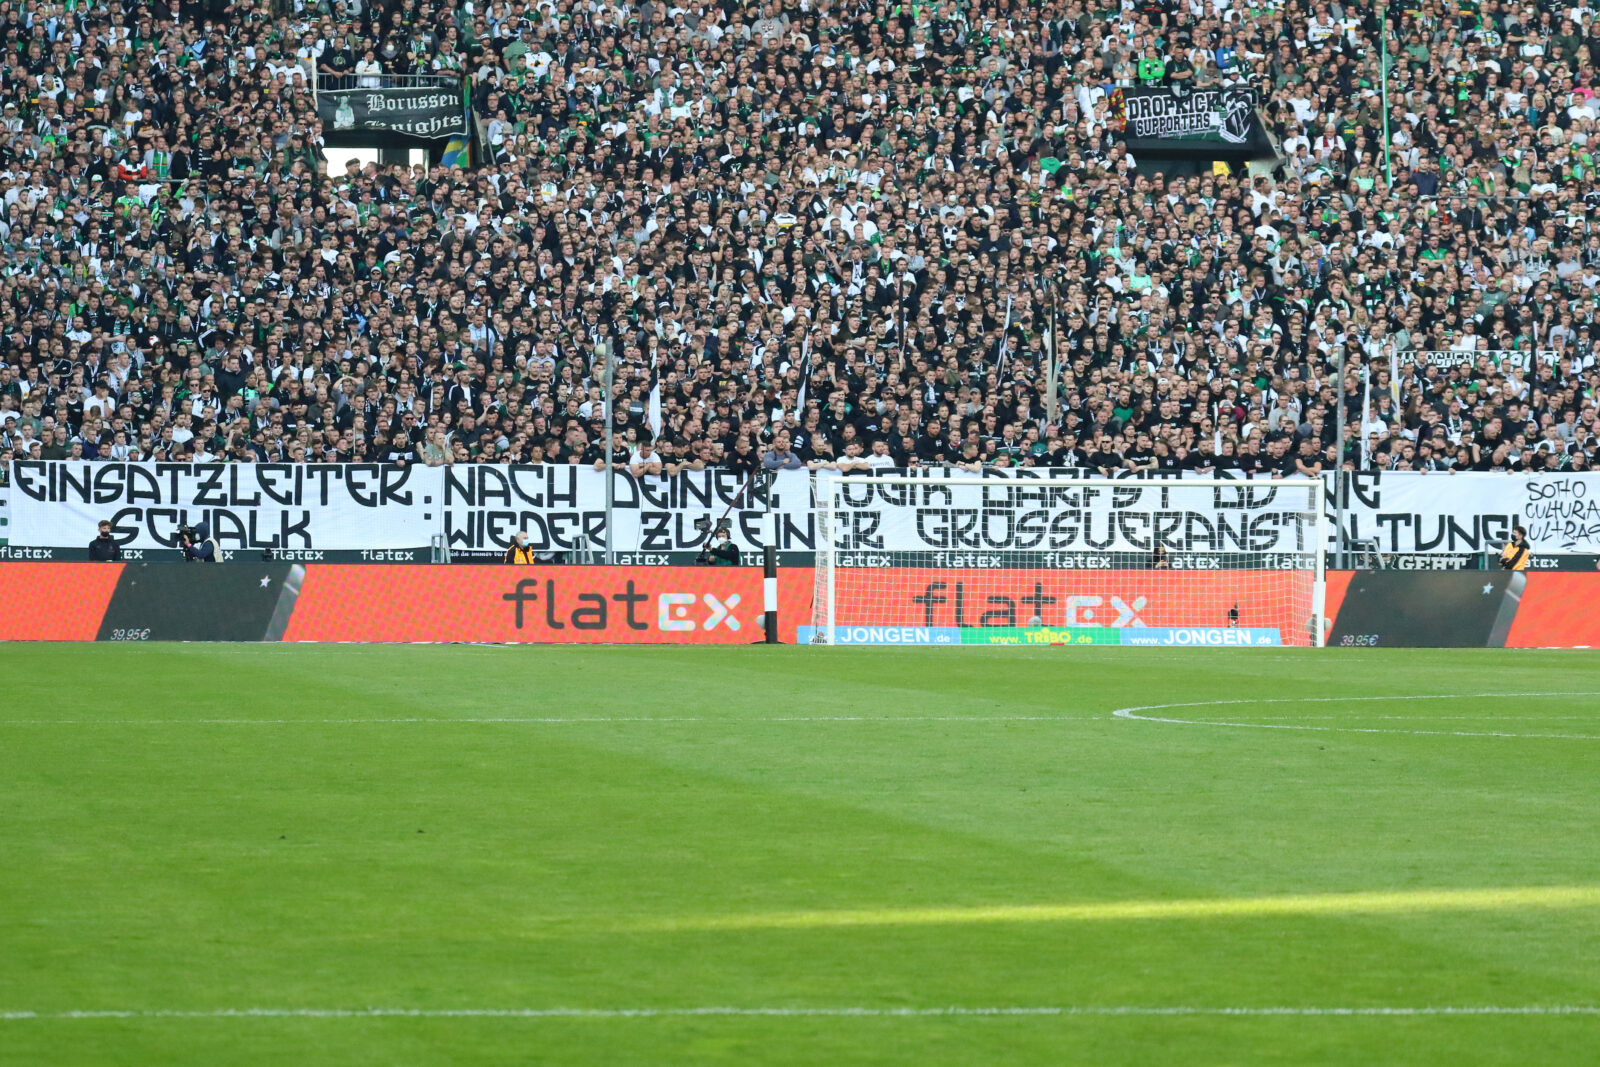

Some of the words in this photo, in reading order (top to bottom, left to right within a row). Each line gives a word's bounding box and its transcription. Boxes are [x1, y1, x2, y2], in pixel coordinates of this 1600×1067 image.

[366, 93, 459, 115] Borussen
[1126, 92, 1219, 120] DROPKICK
[1136, 112, 1211, 137] SUPPORTERS
[444, 465, 577, 508] NACH
[612, 467, 780, 509] DEINER
[983, 467, 1182, 508] DARFST
[1213, 468, 1278, 509] DU
[1308, 470, 1381, 509] NIE
[1525, 500, 1600, 520] CULTURA
[110, 507, 312, 549] SCHALK
[445, 511, 607, 549] WIEDER
[641, 511, 713, 550] ZU
[361, 550, 414, 561] flatex
[835, 552, 891, 567] latex
[934, 553, 1001, 567] flatex
[1044, 553, 1111, 568] flatex
[1171, 555, 1220, 569] atex
[502, 579, 741, 631] flatex
[912, 582, 1147, 627] flatex
[841, 628, 930, 643] JONGEN
[989, 635, 1022, 643] www.
[1131, 636, 1160, 645] www.
[1164, 630, 1251, 645] JONGEN
